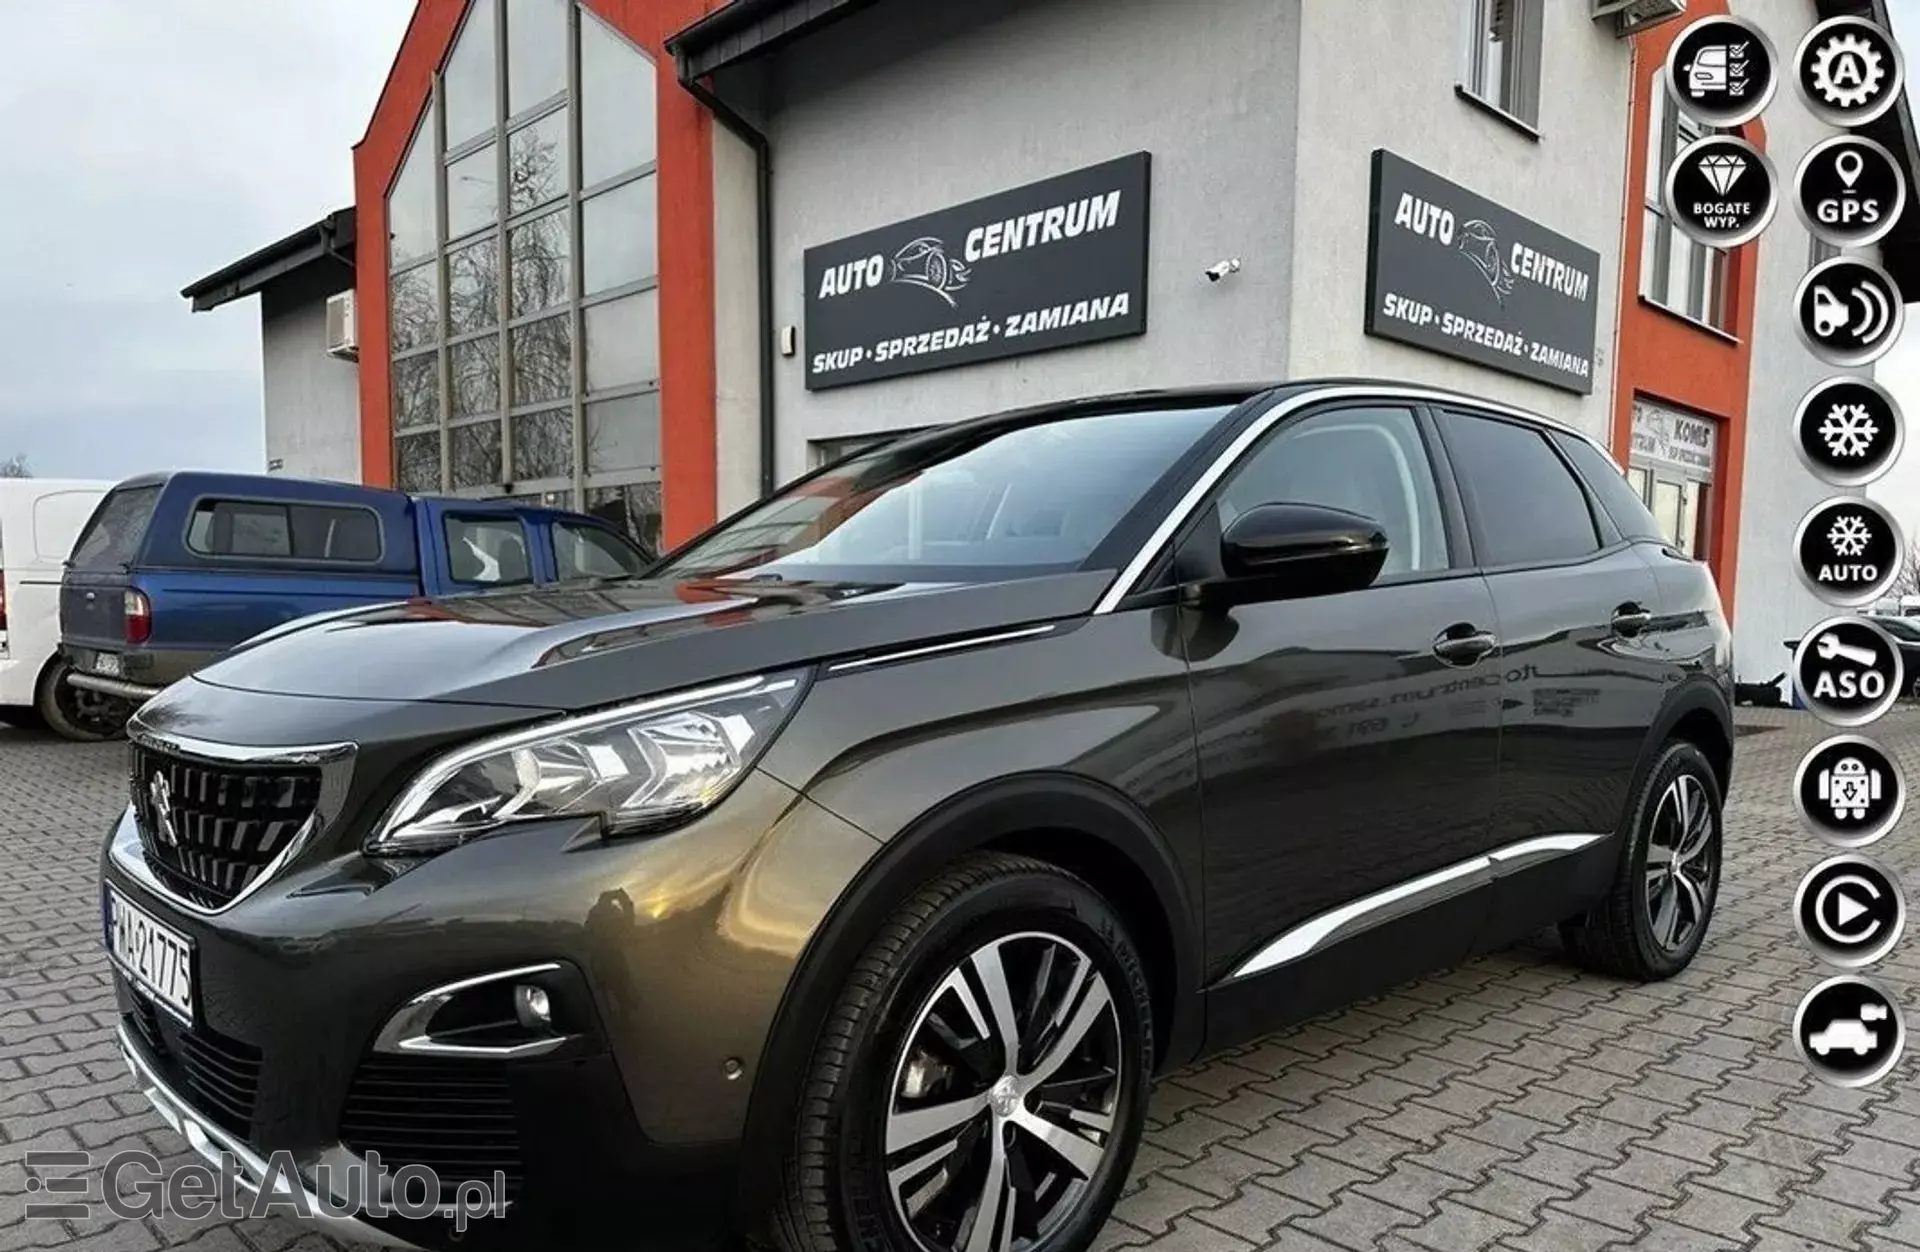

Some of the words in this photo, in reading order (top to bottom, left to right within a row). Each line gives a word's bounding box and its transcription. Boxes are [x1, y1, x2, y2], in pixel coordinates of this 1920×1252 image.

[819, 254, 884, 299] AUTO
[964, 190, 1121, 262] CENTRUM
[1394, 192, 1455, 246] AUTO
[1510, 242, 1589, 301] CENTRUM
[812, 347, 863, 373] SKUP
[874, 315, 991, 362] SPRZEDAŻ
[1005, 292, 1129, 338] ZAMIANA
[1383, 293, 1432, 326] SKUP
[1441, 313, 1523, 356] SPRZEDAŻ
[1530, 341, 1589, 378] ZAMIANA
